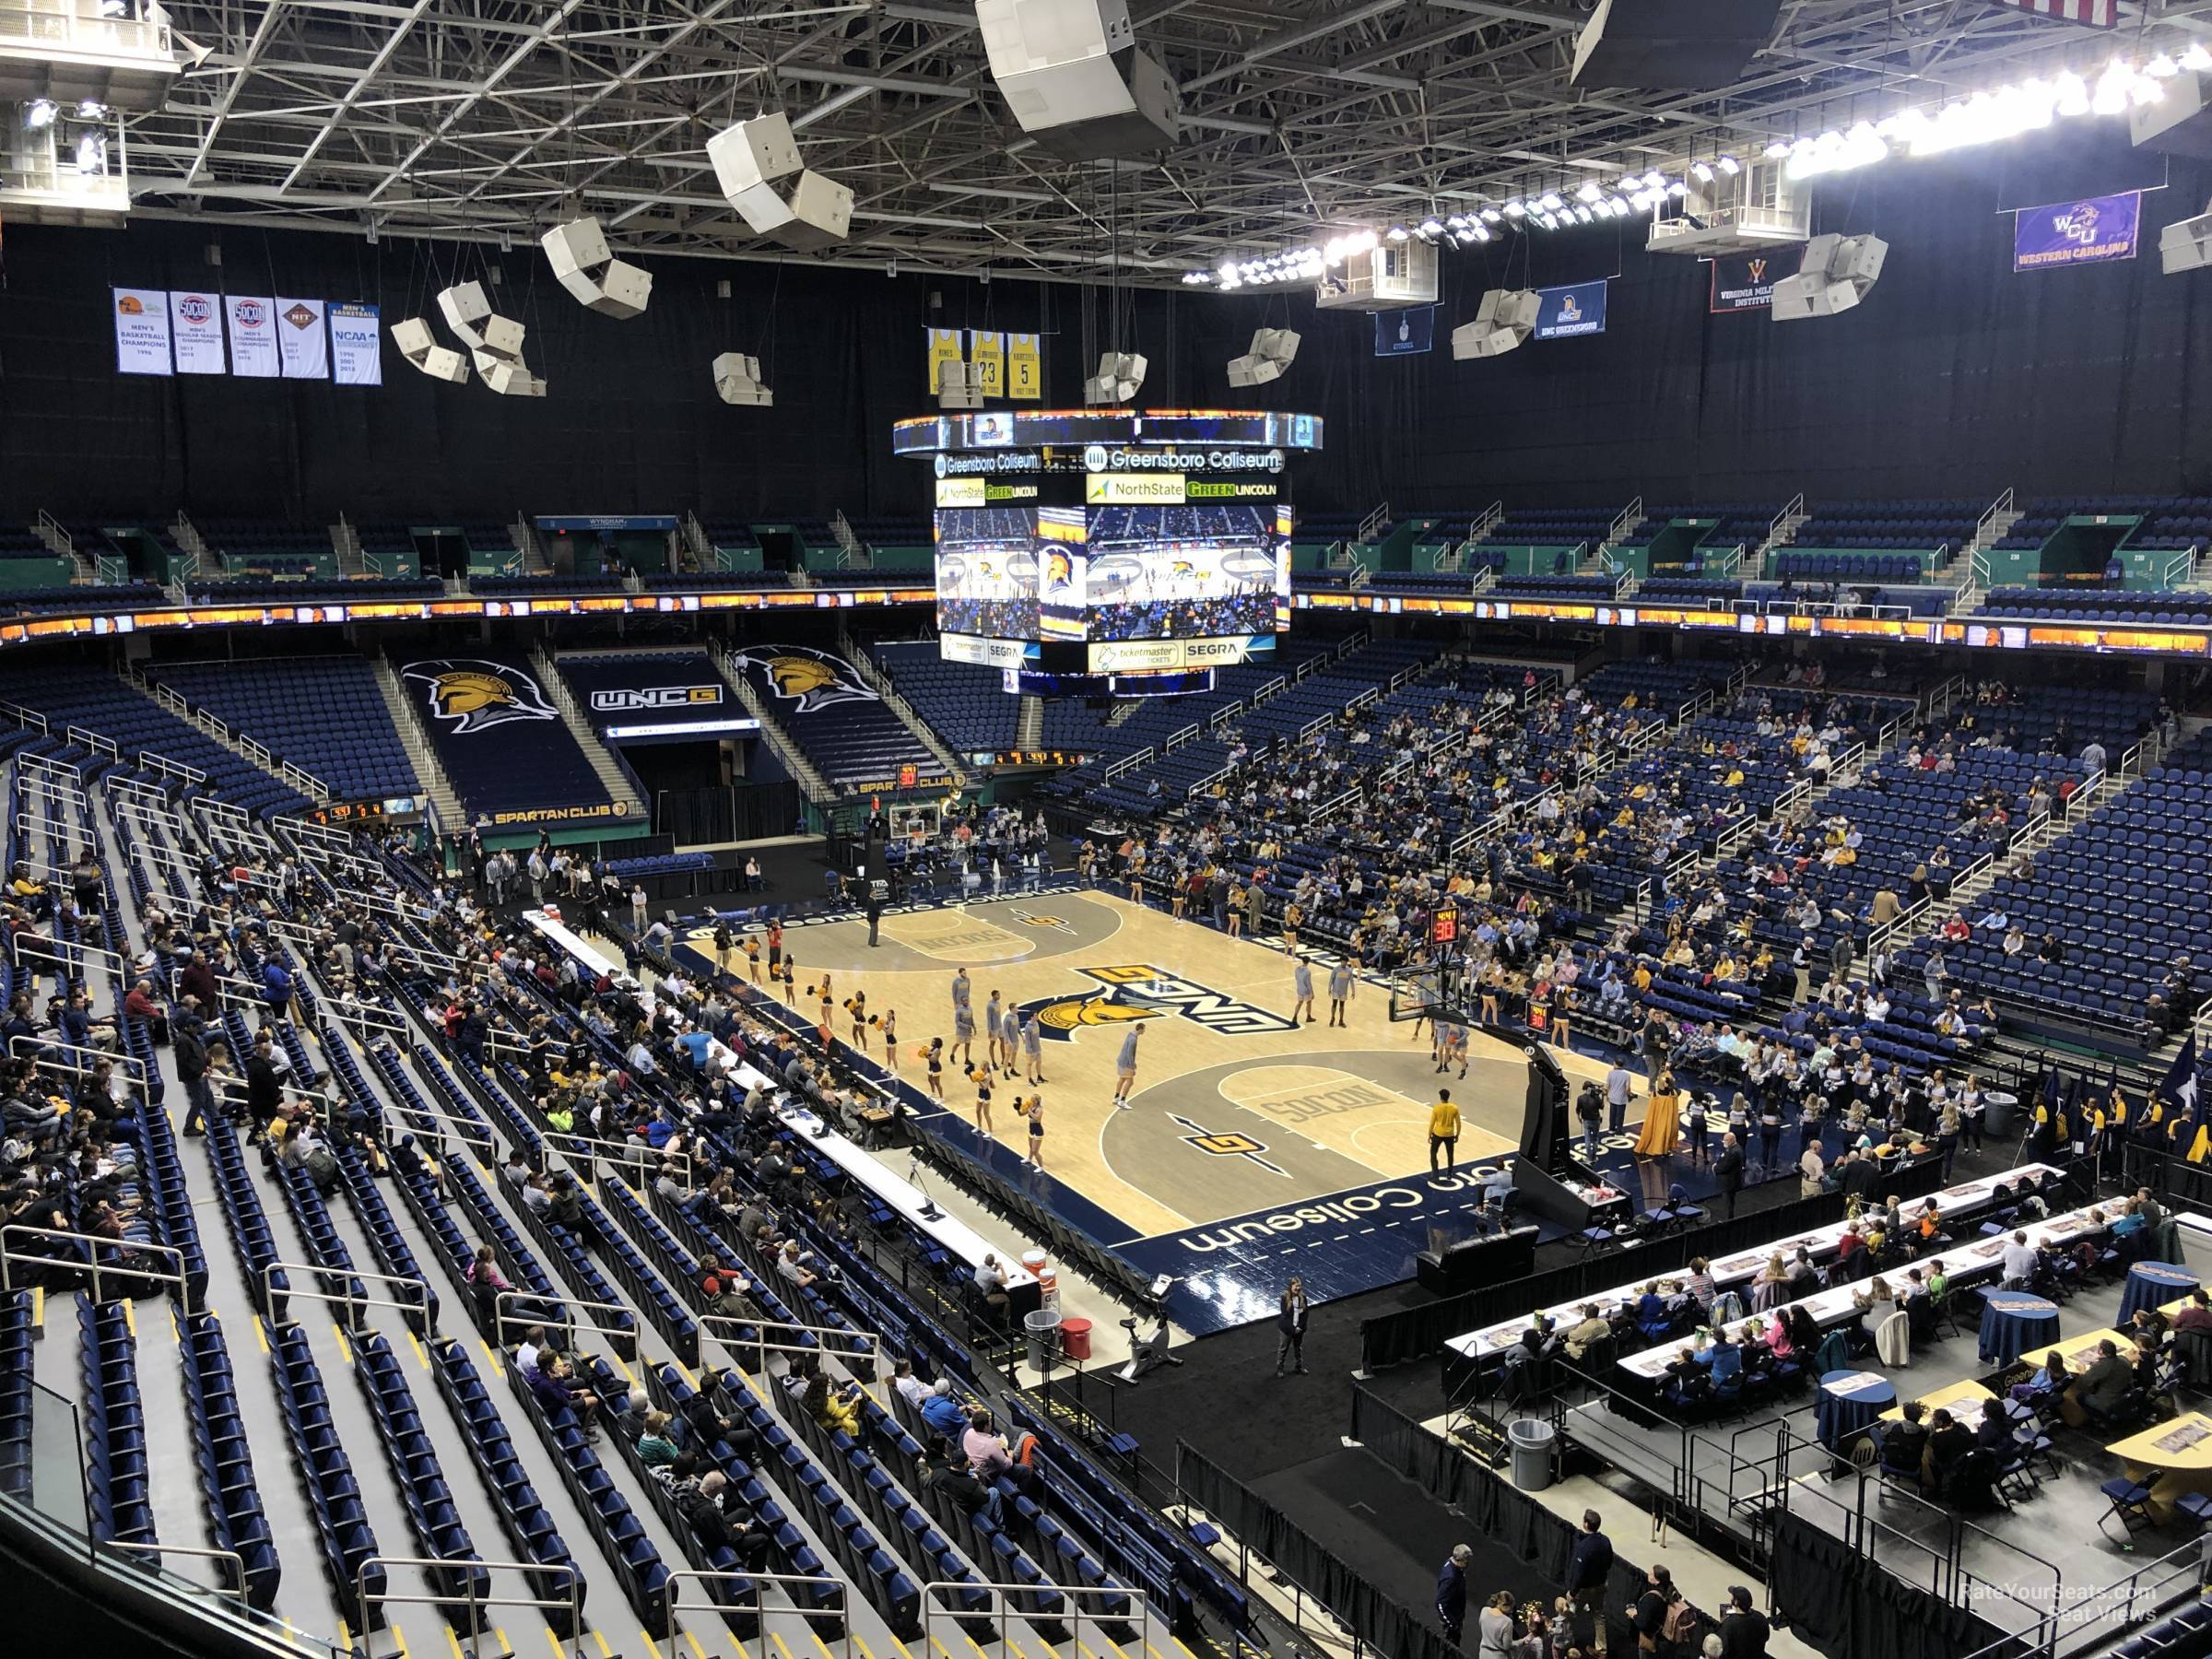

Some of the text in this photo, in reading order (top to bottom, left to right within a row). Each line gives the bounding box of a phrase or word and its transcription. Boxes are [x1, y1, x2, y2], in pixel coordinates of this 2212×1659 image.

[2054, 217, 2097, 243] WCU
[2018, 241, 2129, 265] WESTERN CAROLINA
[1721, 288, 1753, 300] VIRGINIA
[1735, 295, 1771, 307] INSTITUT
[179, 300, 212, 319] SOCON
[235, 305, 266, 322] SOCON
[333, 309, 376, 318] BASKETBALL
[121, 332, 165, 340] BASKETBALL
[335, 331, 367, 341] NCAA
[1541, 326, 1556, 336] UNC
[121, 339, 167, 348] CHAMPIONS
[980, 361, 995, 383] 23
[1021, 364, 1029, 384] 5
[947, 453, 1038, 474] Greensboro Coliseum
[1111, 451, 1278, 468] Greensboro Coliseum
[950, 487, 984, 499] NorthState
[1115, 482, 1182, 496] NorthState
[990, 644, 1018, 658] SEGRA
[1120, 647, 1173, 658] ticketmaster
[1186, 644, 1238, 656] SEGRA
[594, 687, 719, 709] UNCG
[859, 776, 953, 794] SPAR CLUB
[495, 805, 611, 824] SPARTAN CLUB
[942, 886, 1081, 907] Coliseum
[1437, 911, 1457, 921] 4:41
[917, 928, 1010, 950] SOCON
[1434, 921, 1454, 940] 30
[1080, 965, 1297, 1034] UNCG
[1531, 1015, 1544, 1027] 30
[577, 1049, 586, 1059] 20
[1260, 1085, 1395, 1124] SOCON
[1178, 1187, 1423, 1252] Coliseum
